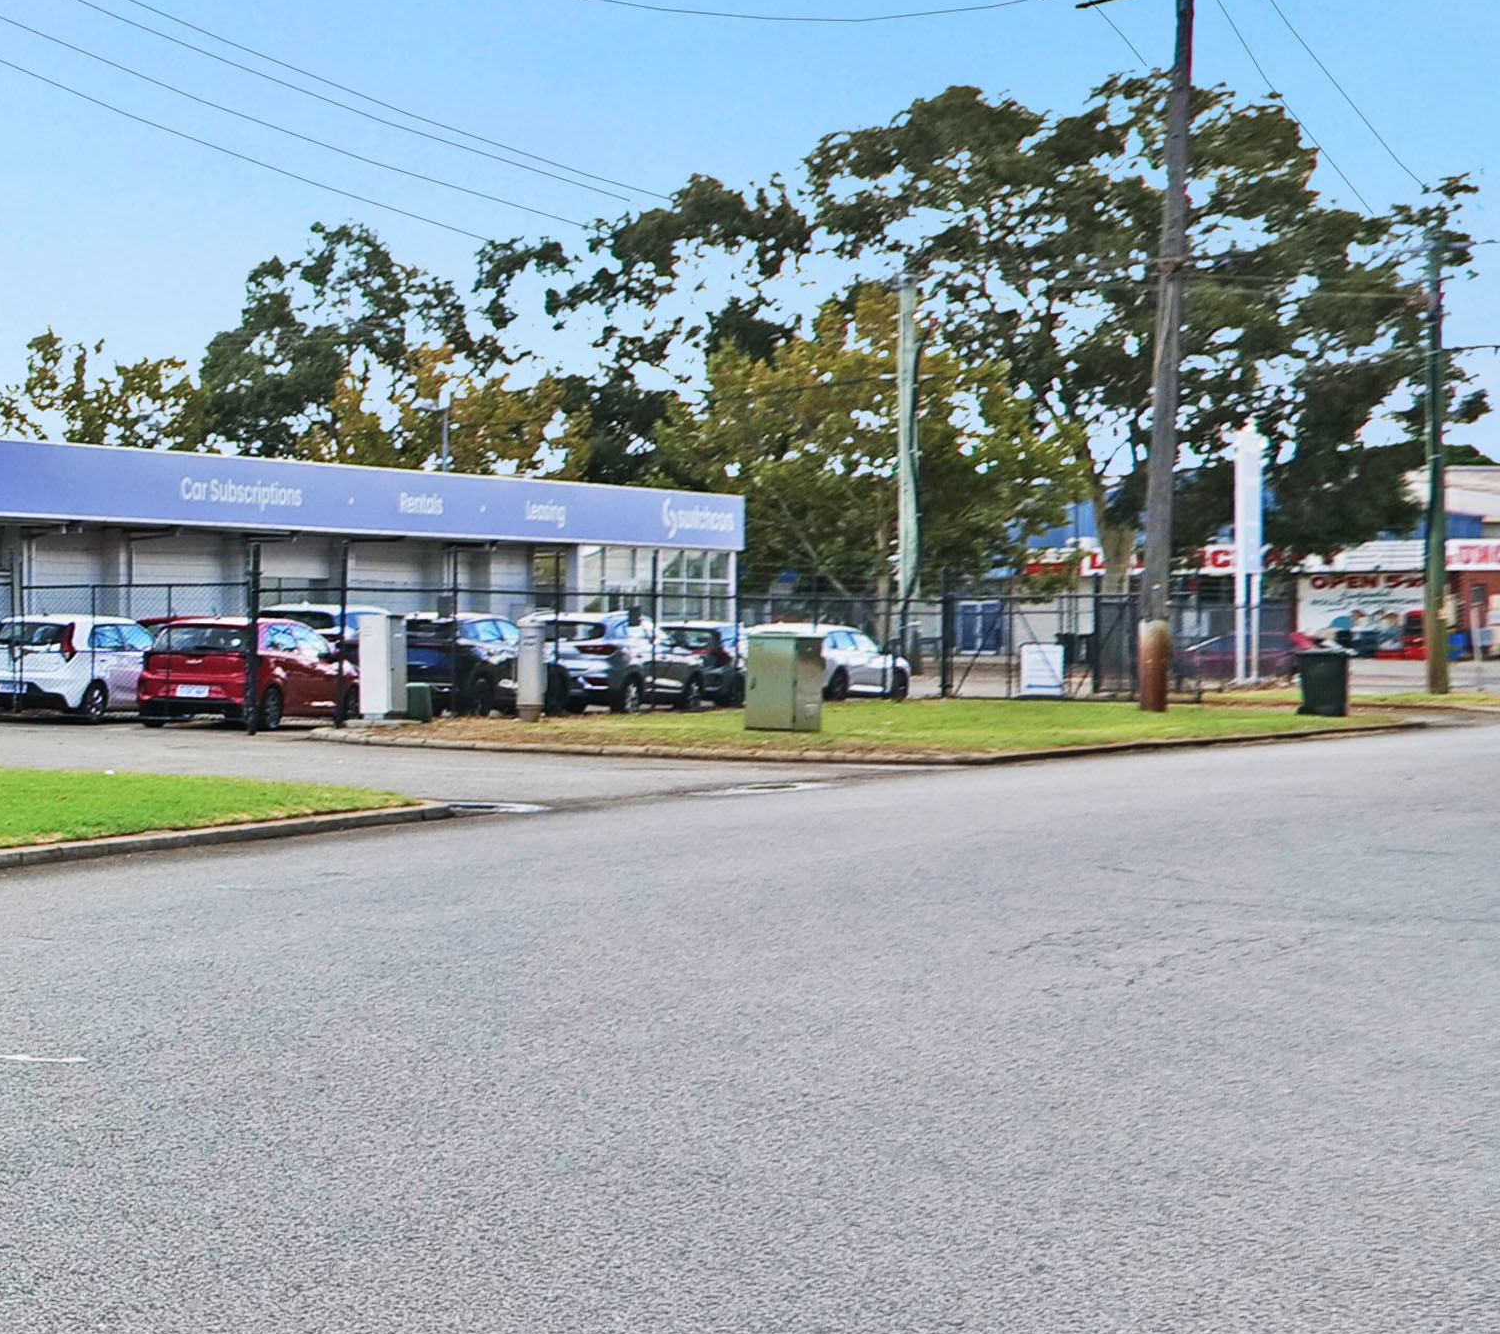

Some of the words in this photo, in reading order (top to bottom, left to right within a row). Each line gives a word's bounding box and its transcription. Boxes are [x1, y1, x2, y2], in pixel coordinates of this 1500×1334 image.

[181, 476, 208, 501] Car
[210, 478, 303, 512] Subscriptions
[399, 491, 444, 516] Rentals
[525, 499, 567, 529] Leasing
